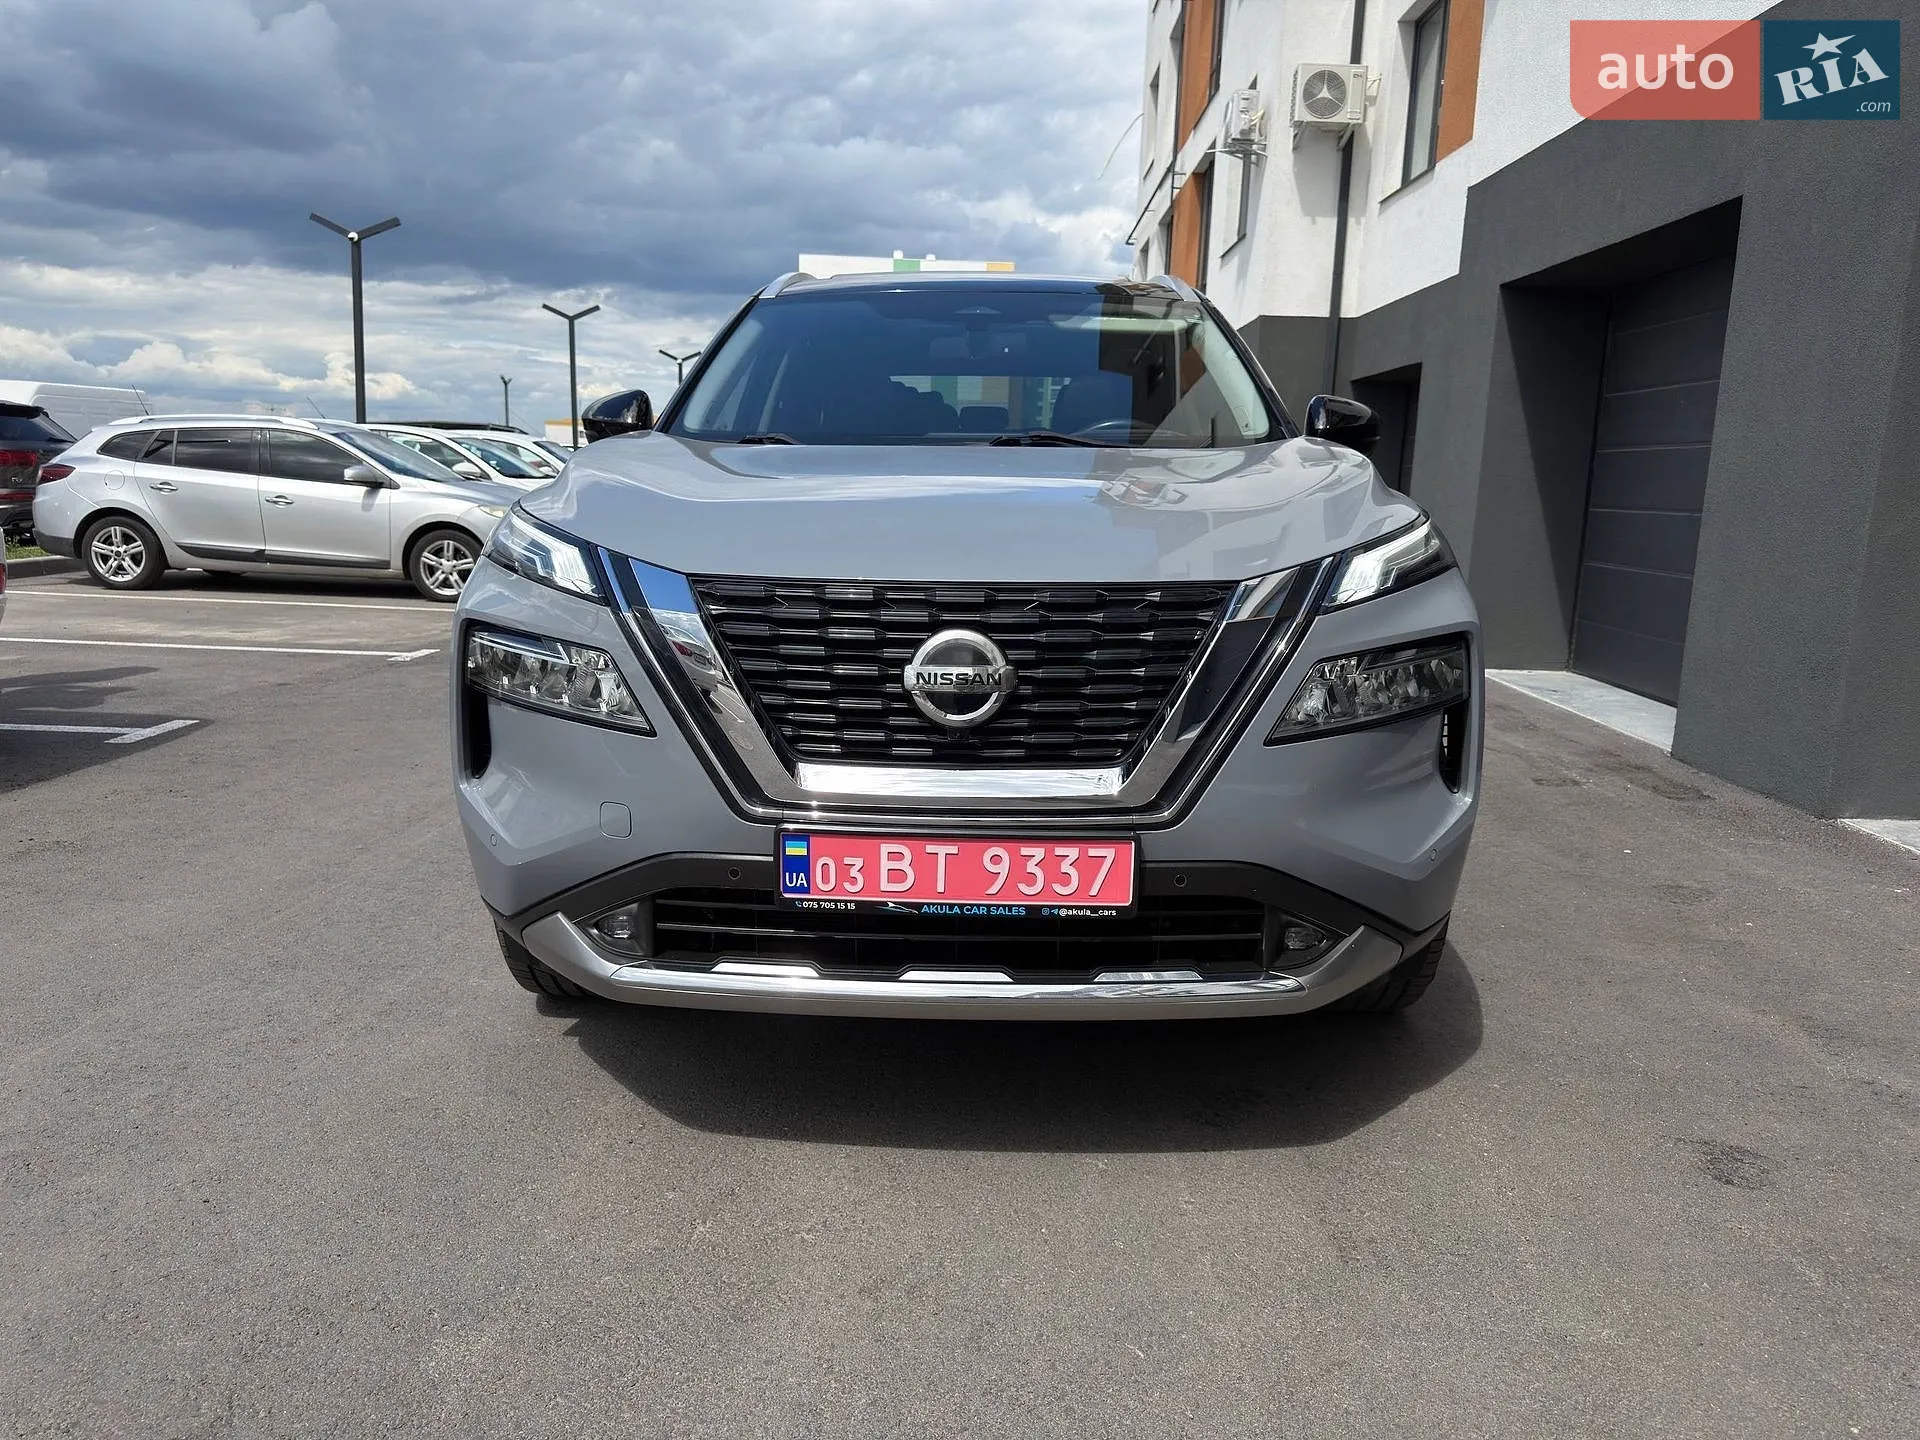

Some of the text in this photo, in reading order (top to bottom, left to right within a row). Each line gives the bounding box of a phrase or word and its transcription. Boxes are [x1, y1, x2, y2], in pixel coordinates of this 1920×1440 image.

[915, 672, 1002, 686] NISSAN
[815, 843, 1117, 897] 03 BT 9337
[785, 871, 808, 888] UA
[802, 901, 856, 910] 075 705 15 15
[921, 904, 1026, 916] AKULA CAR SALES
